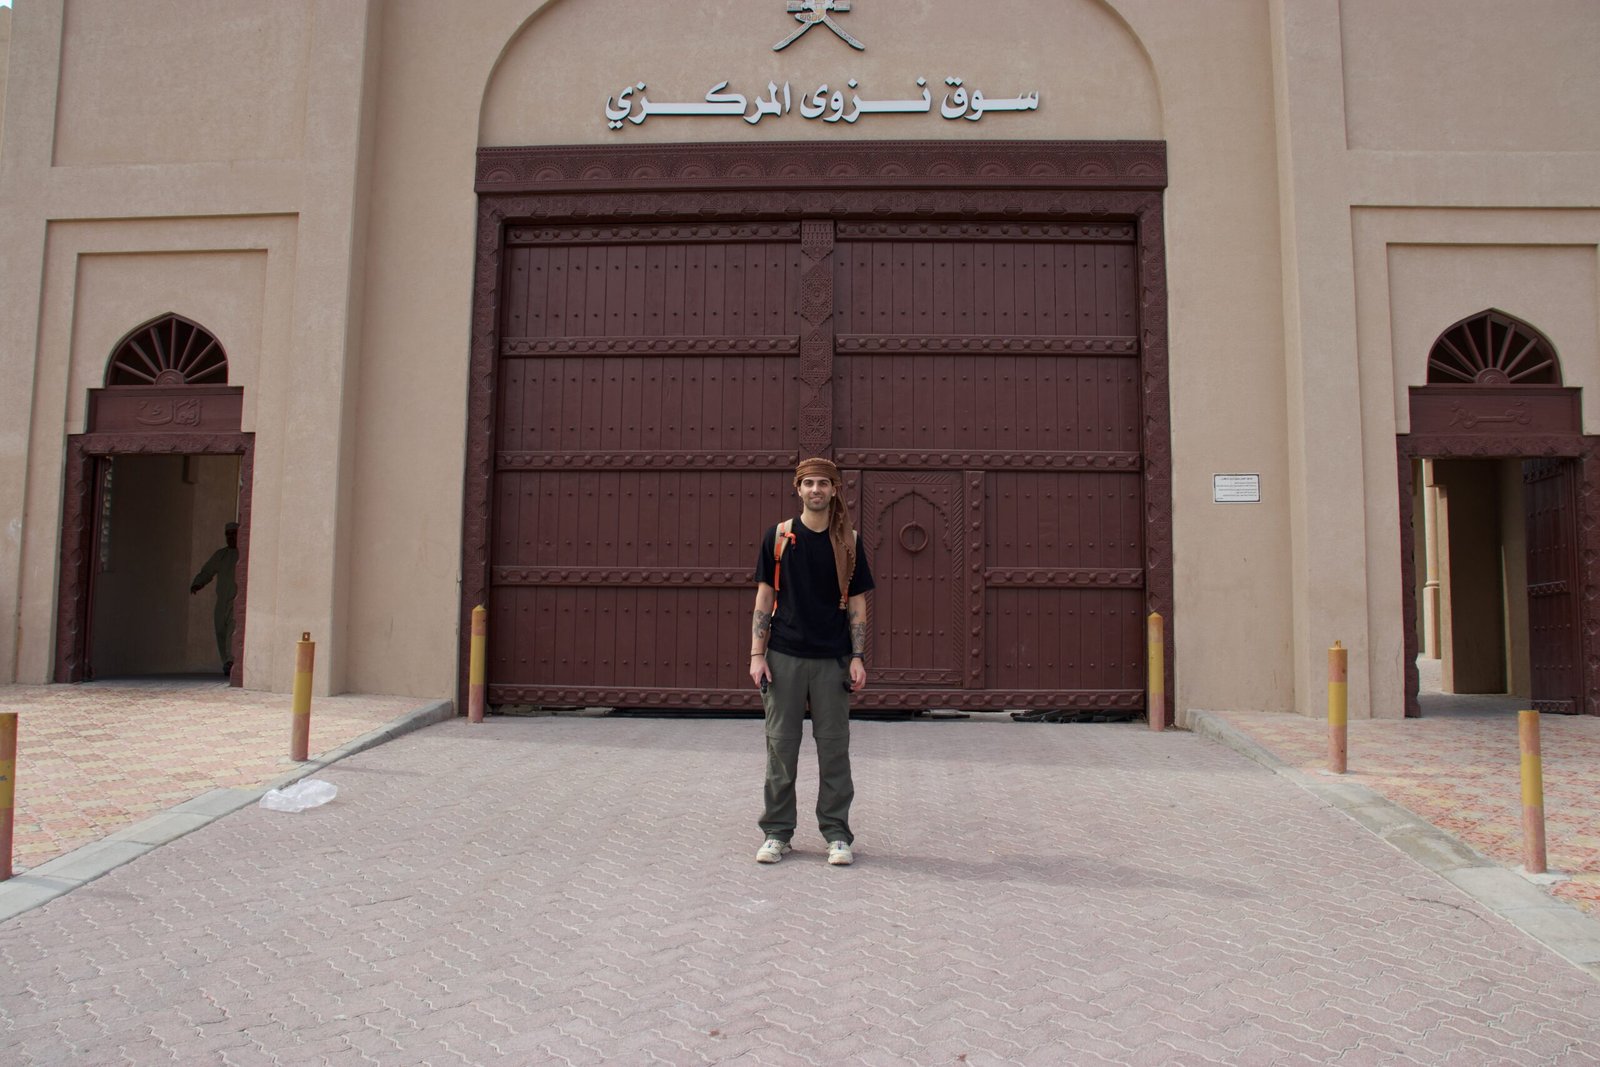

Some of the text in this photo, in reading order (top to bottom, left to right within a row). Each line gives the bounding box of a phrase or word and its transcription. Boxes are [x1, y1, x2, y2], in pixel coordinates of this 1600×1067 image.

[605, 76, 1039, 129] سوق نزوى المركزي
